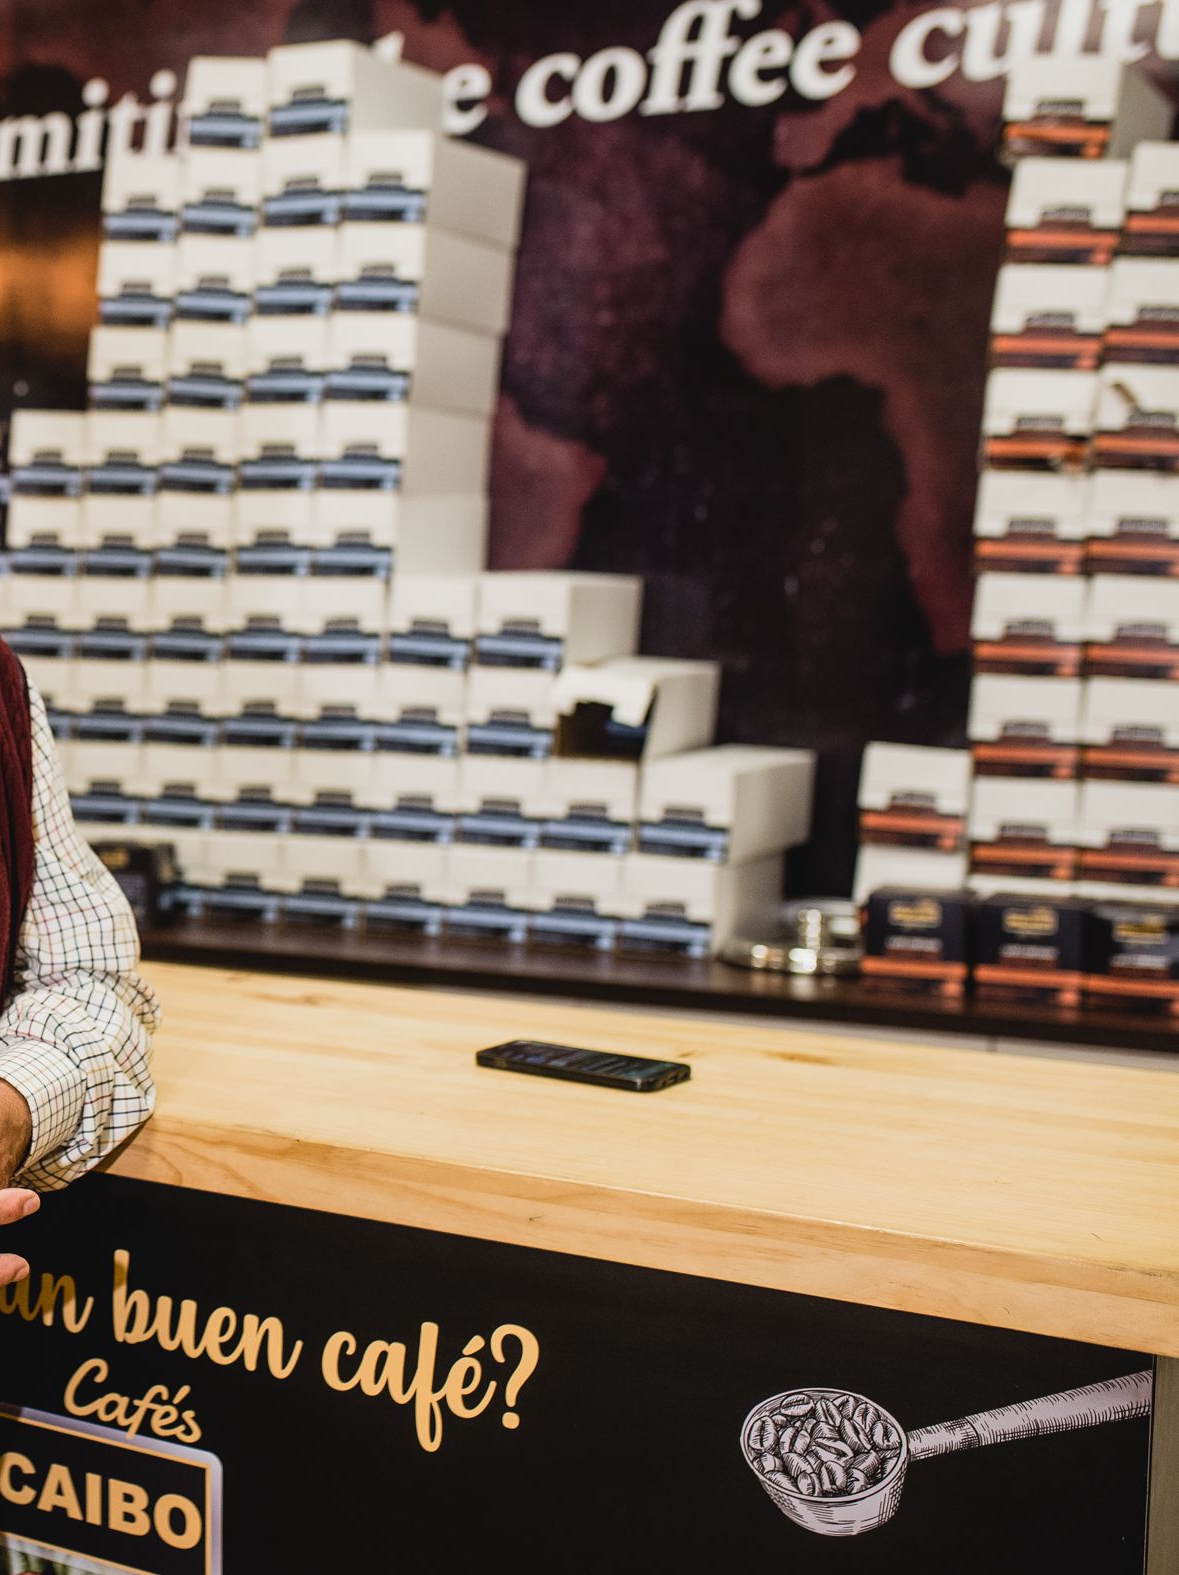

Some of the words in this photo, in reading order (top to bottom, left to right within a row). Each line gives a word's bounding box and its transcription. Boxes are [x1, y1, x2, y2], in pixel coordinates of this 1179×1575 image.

[514, 0, 861, 128] coffee
[63, 1357, 203, 1444] Cafés
[112, 1249, 304, 1379] buen
[321, 1321, 540, 1453] café?
